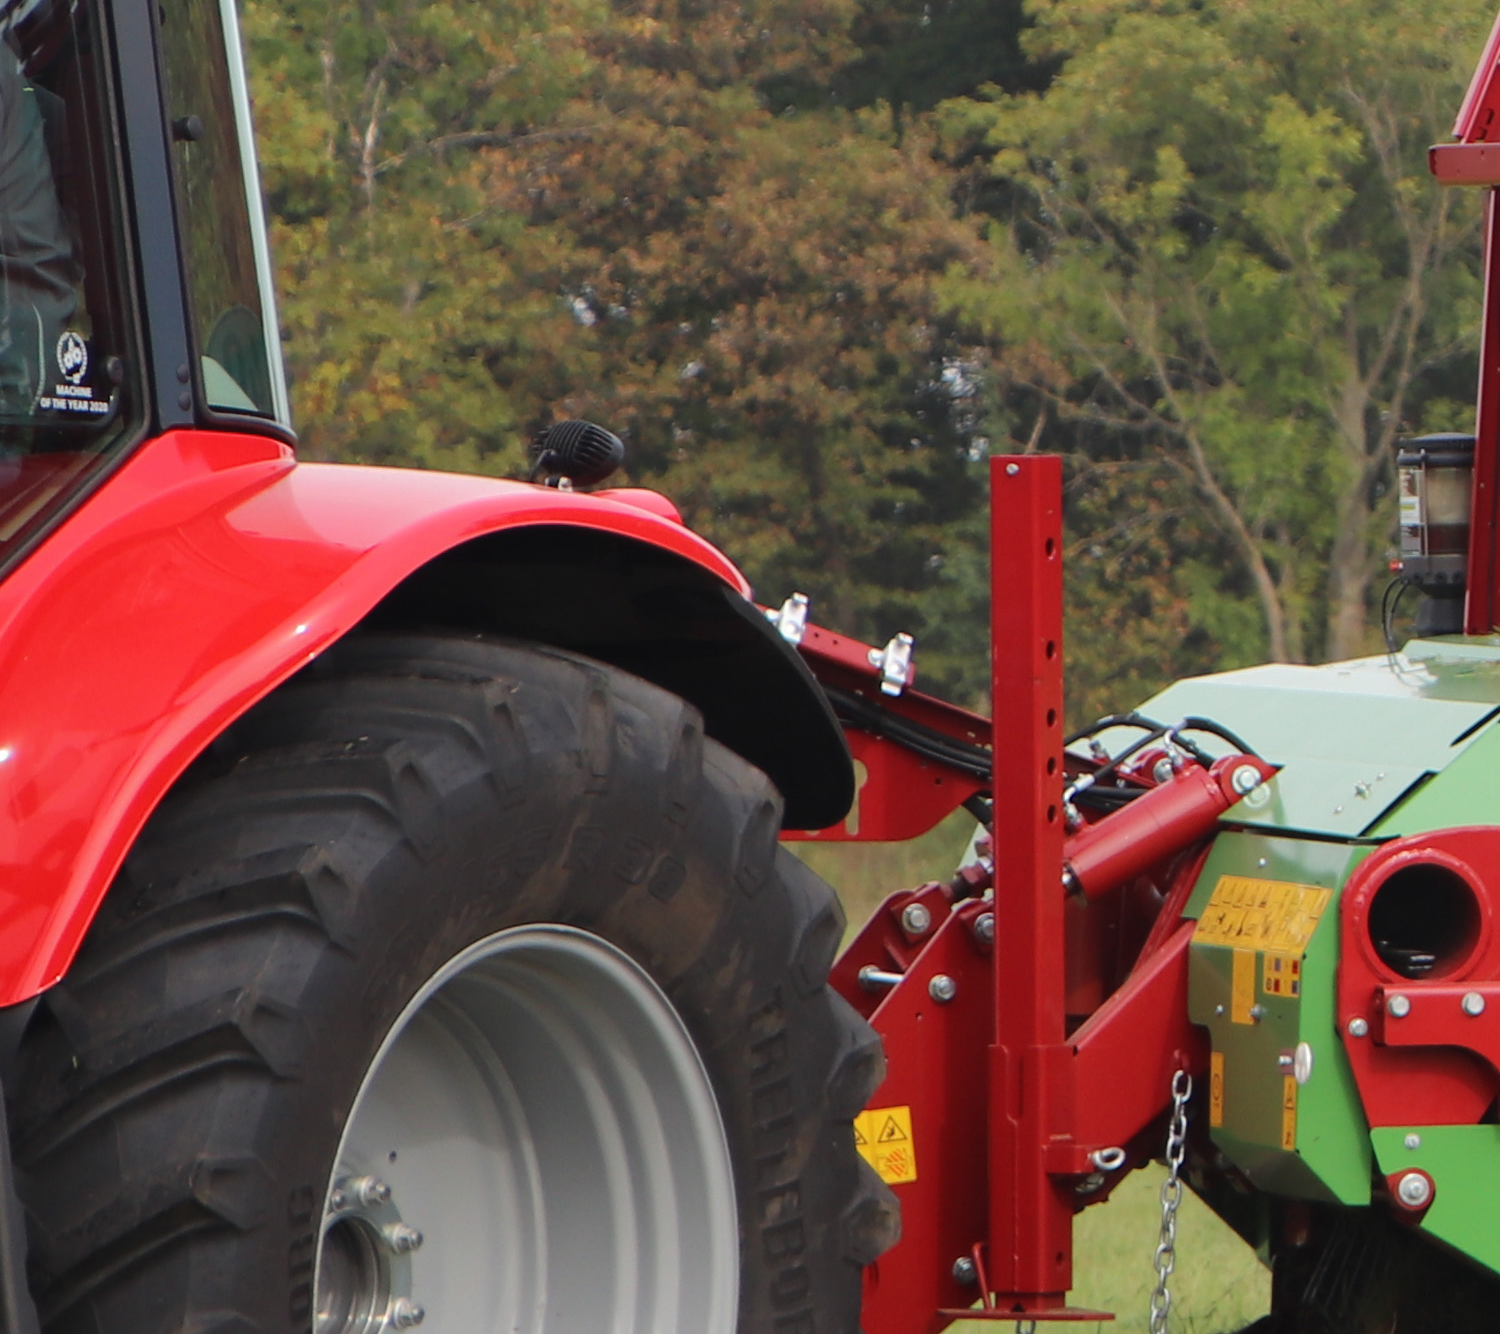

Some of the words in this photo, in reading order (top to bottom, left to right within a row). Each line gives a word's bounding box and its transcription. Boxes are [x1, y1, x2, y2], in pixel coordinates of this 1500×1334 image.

[55, 384, 92, 398] MACHINE
[40, 397, 51, 408] OF
[52, 398, 67, 409] THE
[67, 399, 89, 411] YEAR
[89, 400, 109, 412] 2020
